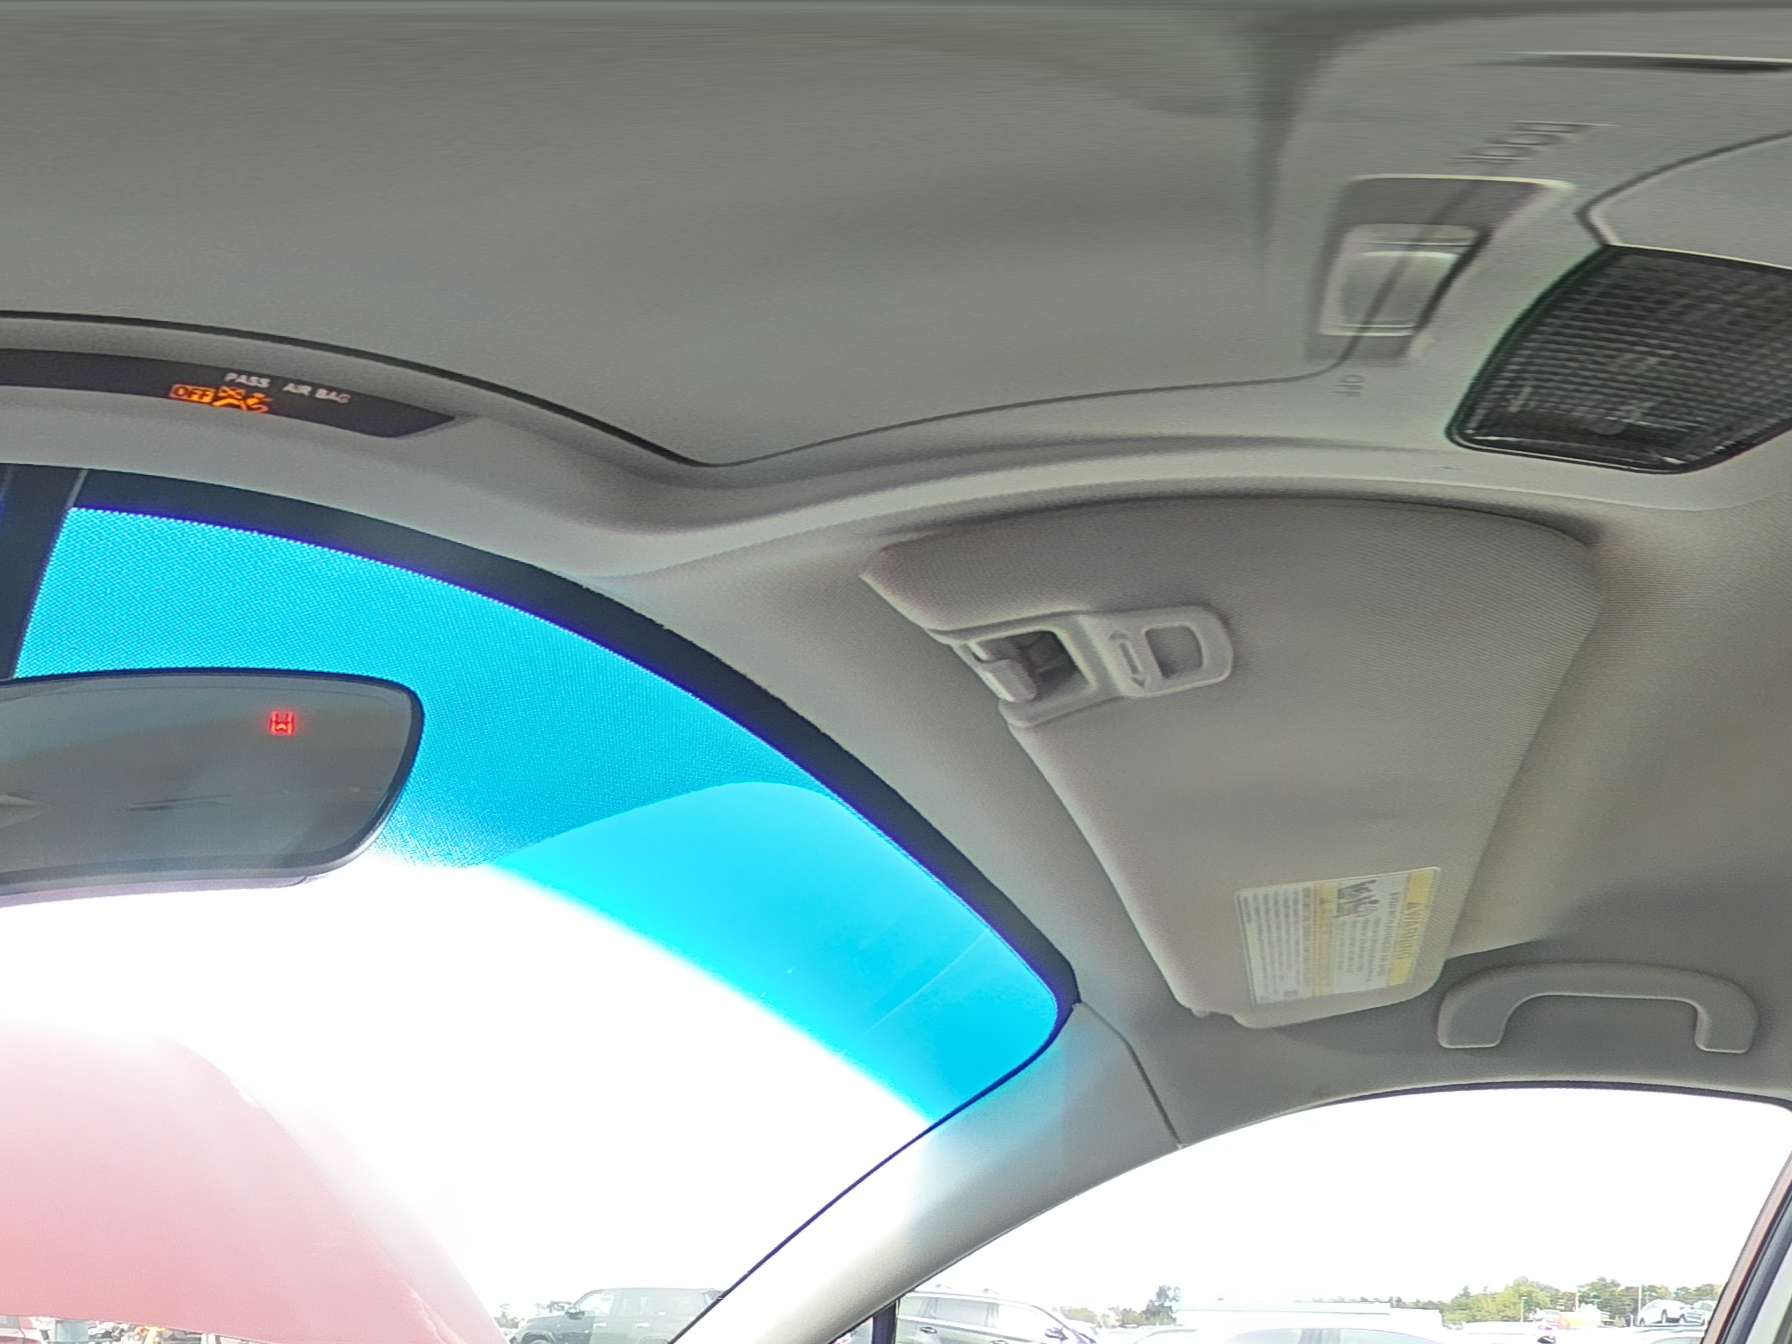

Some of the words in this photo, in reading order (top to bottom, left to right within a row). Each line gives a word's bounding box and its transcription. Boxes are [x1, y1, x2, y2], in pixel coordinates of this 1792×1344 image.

[172, 385, 216, 402] OFF
[224, 372, 271, 388] PASS
[282, 382, 312, 396] AIR
[315, 388, 351, 404] BAG
[1400, 908, 1424, 959] WARNING
